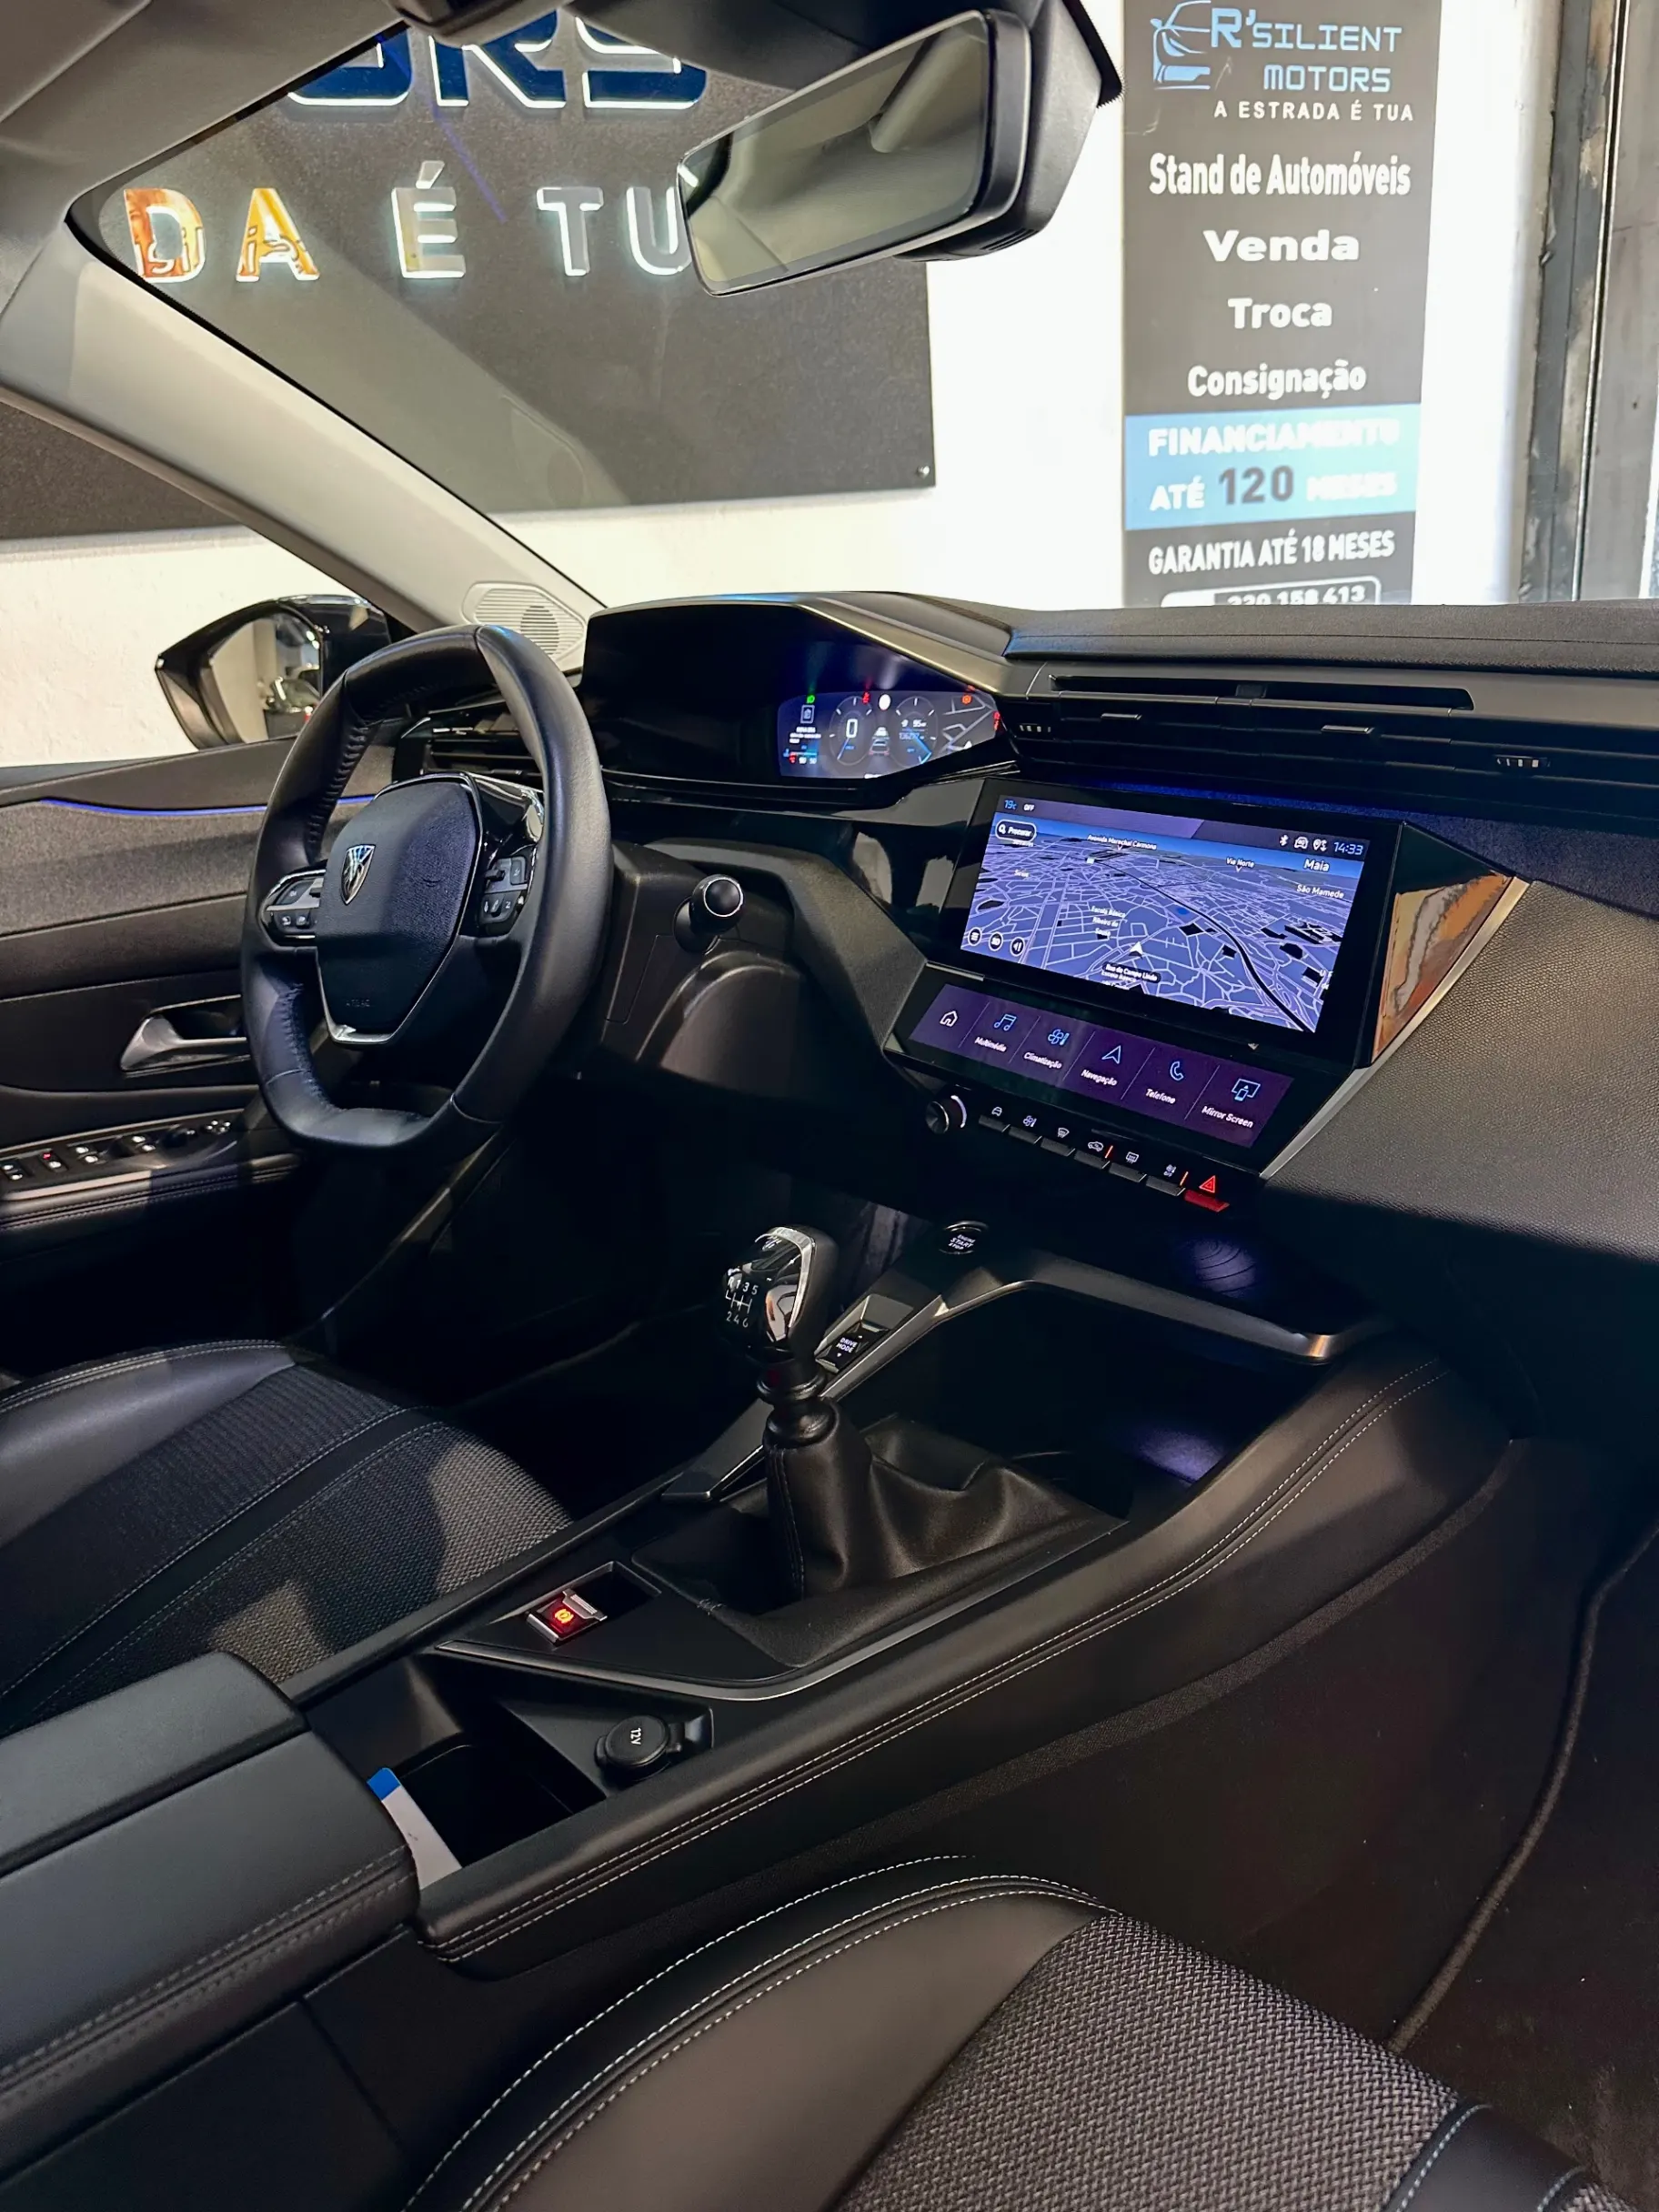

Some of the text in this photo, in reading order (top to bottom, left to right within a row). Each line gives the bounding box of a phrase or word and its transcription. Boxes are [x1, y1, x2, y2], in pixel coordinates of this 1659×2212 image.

[1263, 64, 1392, 93] MOTORS
[1213, 99, 1413, 122] A ESTRADA É TUA
[1149, 150, 1412, 196] Stand de Automóveis
[391, 160, 467, 279] É
[1202, 229, 1360, 262] Venda
[1227, 297, 1332, 329] Troca
[1187, 358, 1367, 400] Consignação
[1149, 475, 1205, 511] ATÉ
[1218, 465, 1294, 505] 120
[1148, 528, 1395, 575] GARANTIA ATÉ 18 MESES
[1333, 841, 1363, 856] 14:33
[1237, 859, 1254, 868] Norte
[1303, 859, 1330, 872] Maia
[1296, 884, 1344, 899] São Mamede
[974, 1035, 1008, 1053] Multimédia
[1023, 1051, 1062, 1071] Climatização
[1081, 1069, 1118, 1087] Navegação
[1145, 1088, 1176, 1105] Telefone
[1202, 1104, 1254, 1130] Mirror Screen
[950, 1237, 974, 1249] START
[836, 1342, 855, 1353] MODE
[840, 1337, 858, 1348] DRIVE
[630, 1727, 641, 1745] 12V
